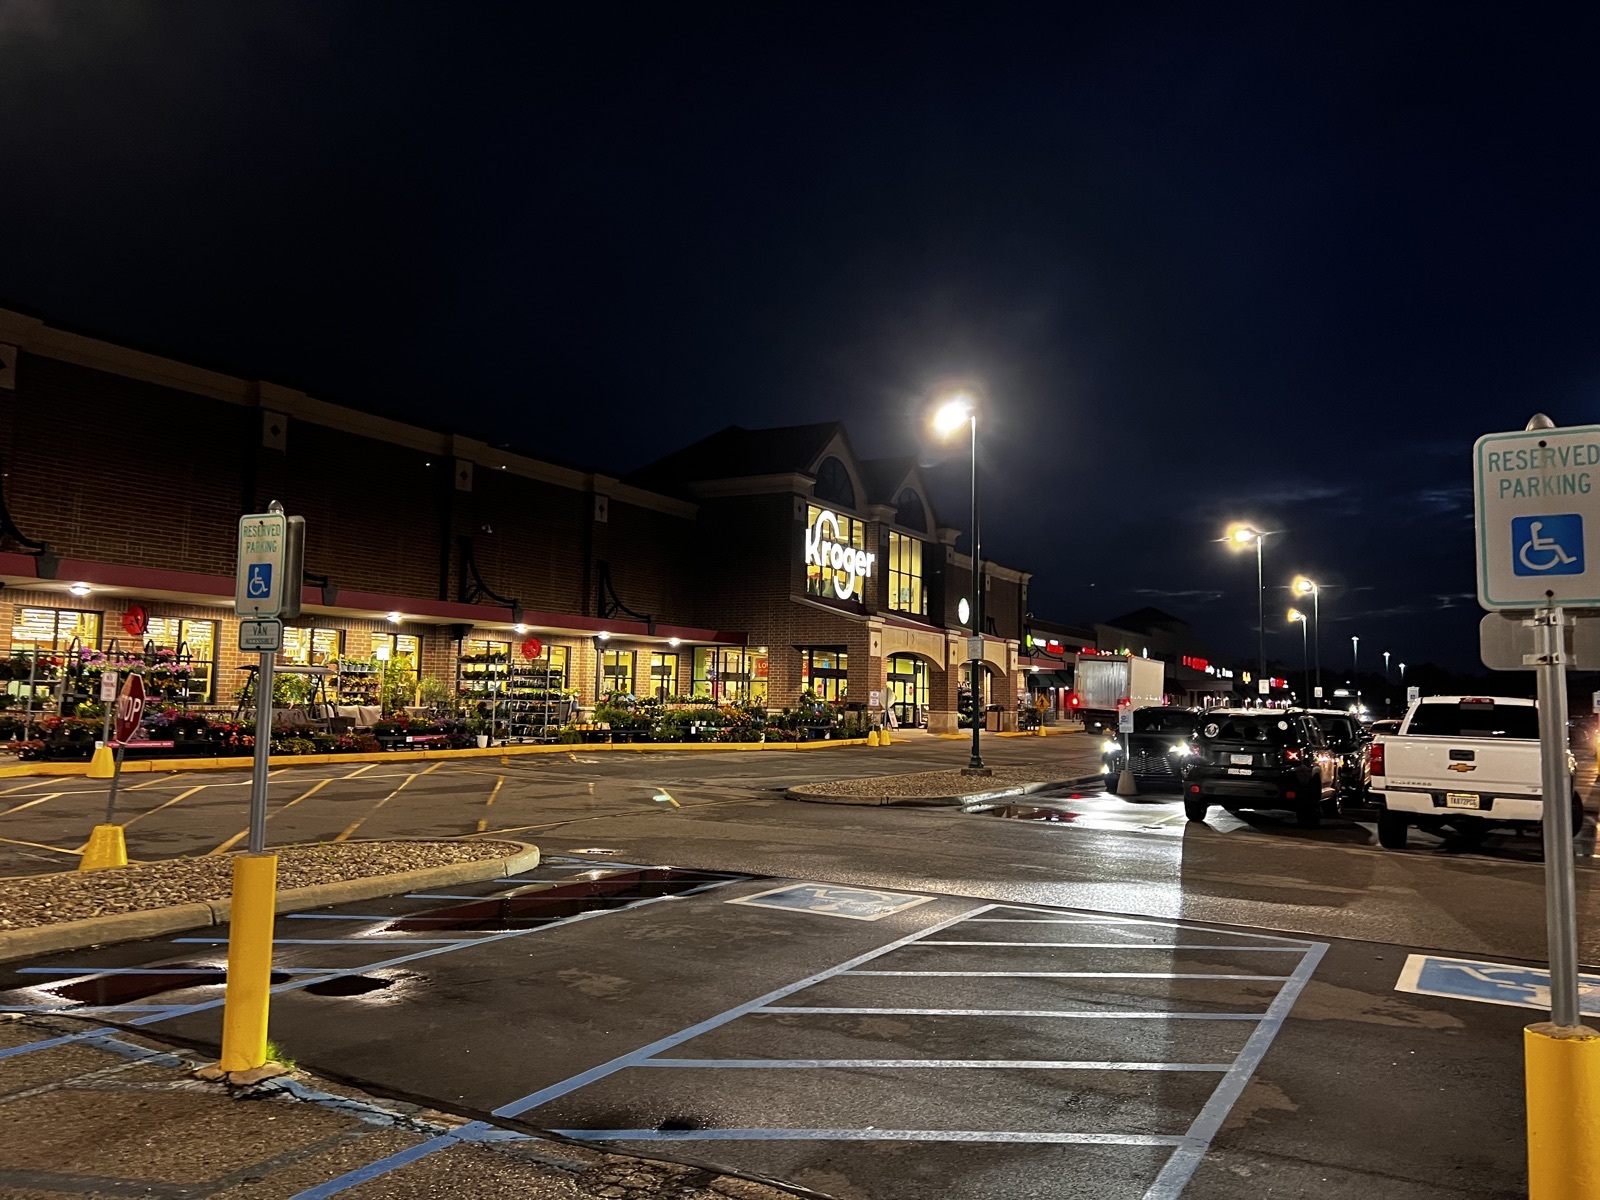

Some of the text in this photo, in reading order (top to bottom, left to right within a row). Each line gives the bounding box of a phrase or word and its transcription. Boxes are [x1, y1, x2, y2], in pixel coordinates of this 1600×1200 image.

[1488, 444, 1600, 472] RESERVED
[1499, 474, 1592, 499] PARKING
[244, 525, 281, 537] RESERVED
[246, 541, 277, 554] PARKING
[805, 510, 875, 600] Kroger
[252, 626, 268, 636] VAN
